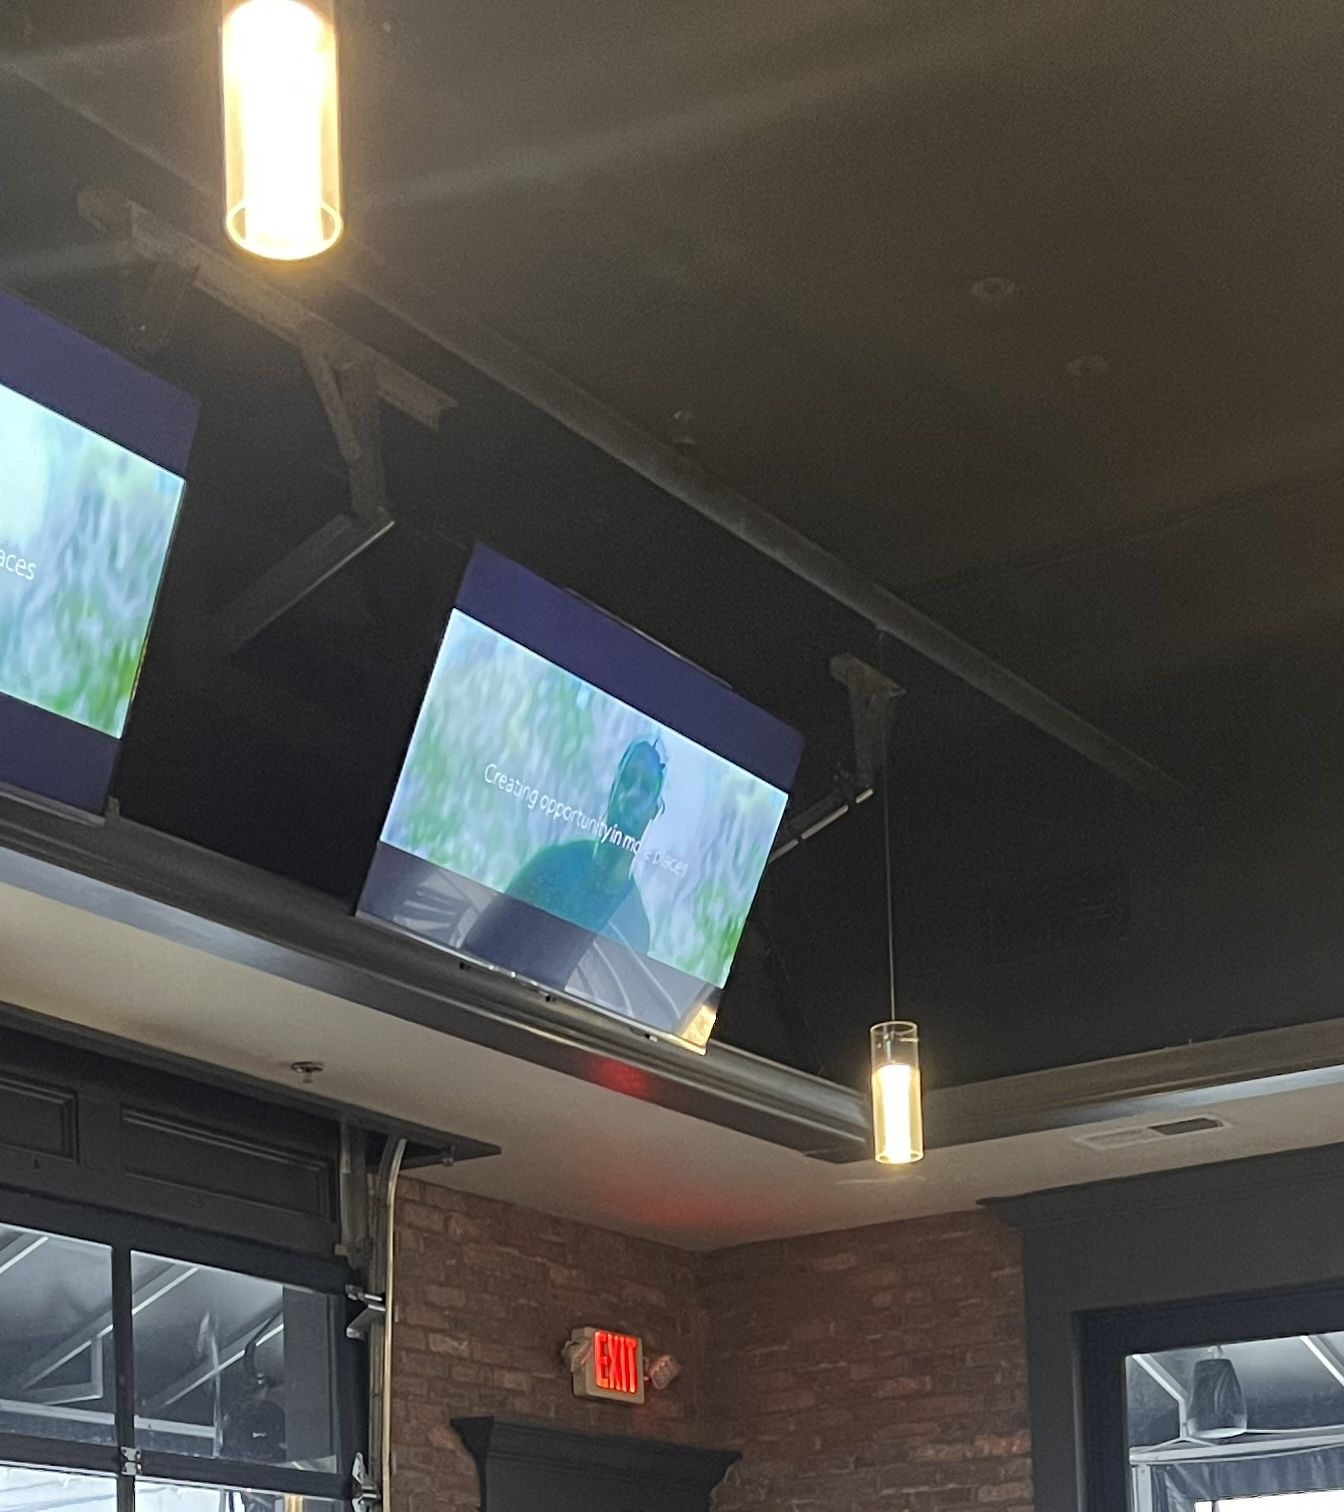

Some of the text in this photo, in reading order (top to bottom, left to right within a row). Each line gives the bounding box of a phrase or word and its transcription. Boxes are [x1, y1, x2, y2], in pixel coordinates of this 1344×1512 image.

[484, 763, 690, 878] Creating opportunity in moe places
[595, 1331, 638, 1393] EXIT
